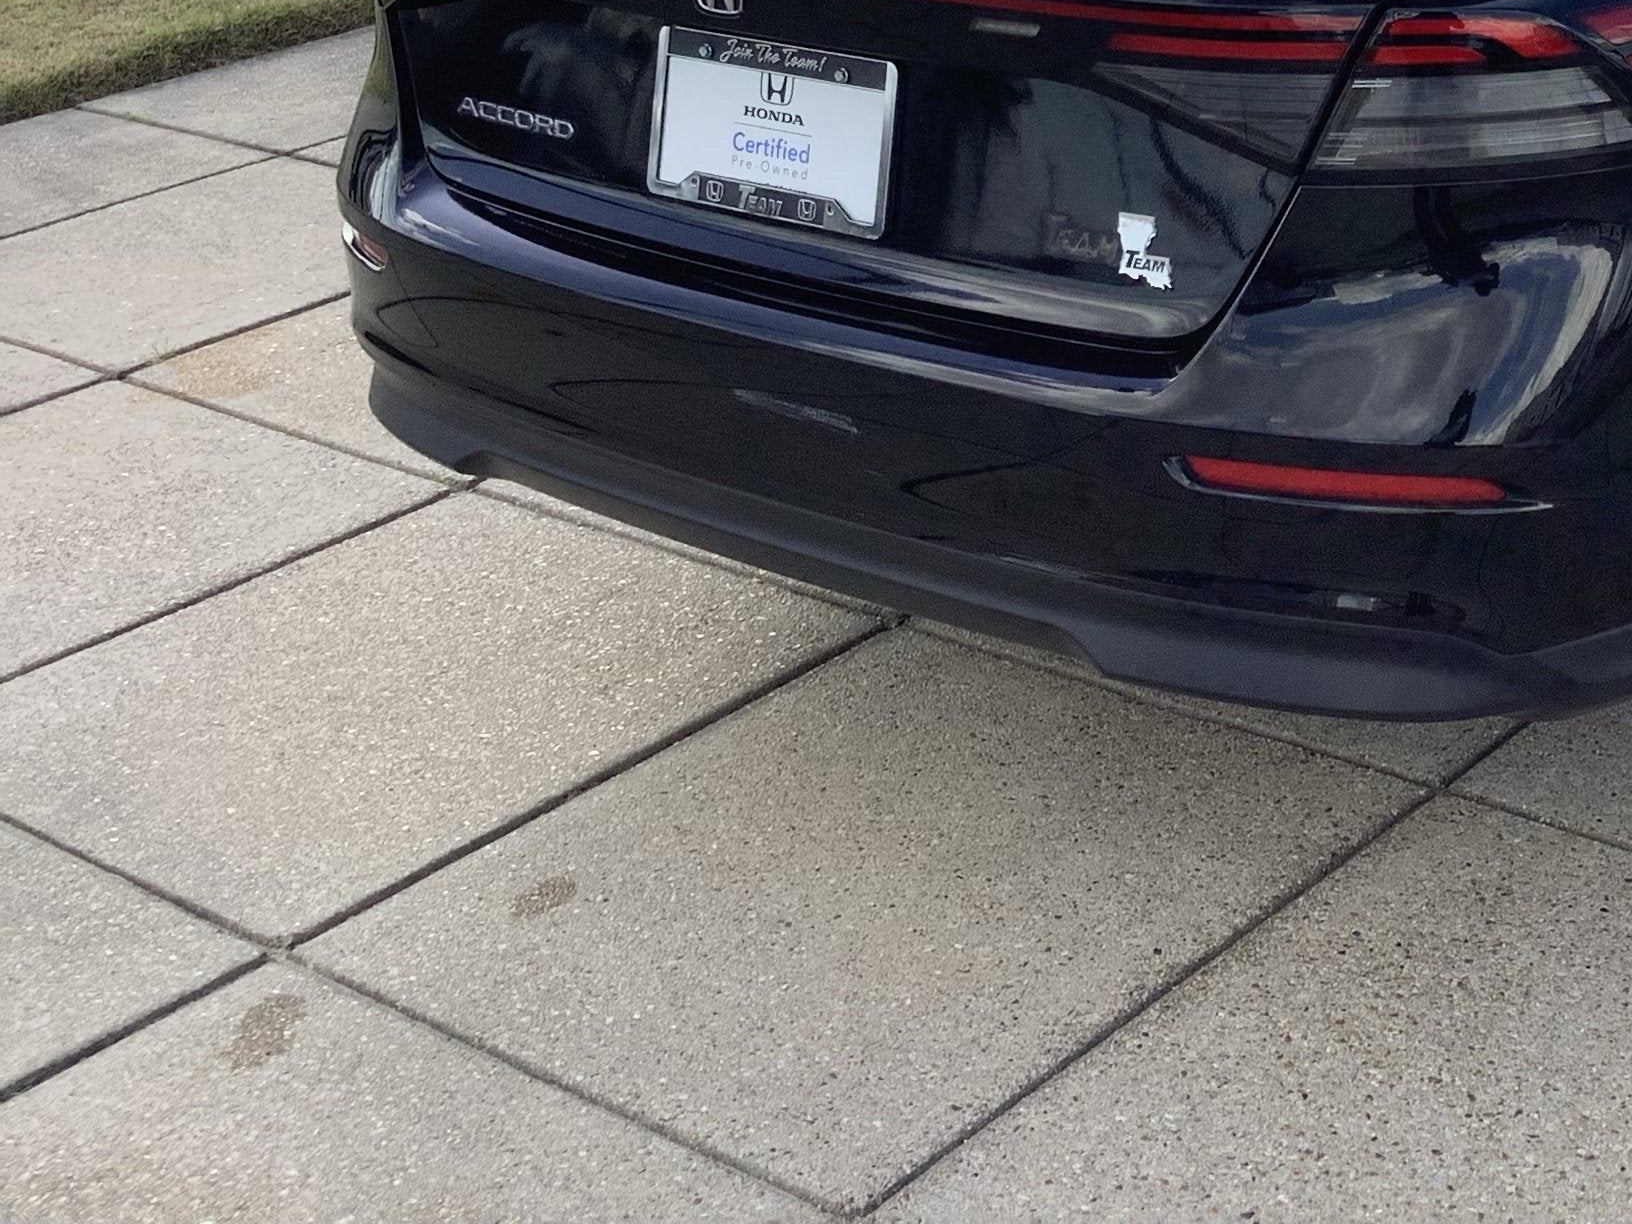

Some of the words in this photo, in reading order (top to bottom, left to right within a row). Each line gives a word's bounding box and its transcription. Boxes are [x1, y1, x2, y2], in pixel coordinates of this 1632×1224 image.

[719, 38, 754, 63] Join
[755, 42, 781, 64] The
[782, 47, 828, 73] Team!
[457, 96, 574, 139] ACCORD
[743, 105, 805, 127] HONDA
[732, 131, 812, 165] Certified
[731, 155, 809, 181] Pre-Owned
